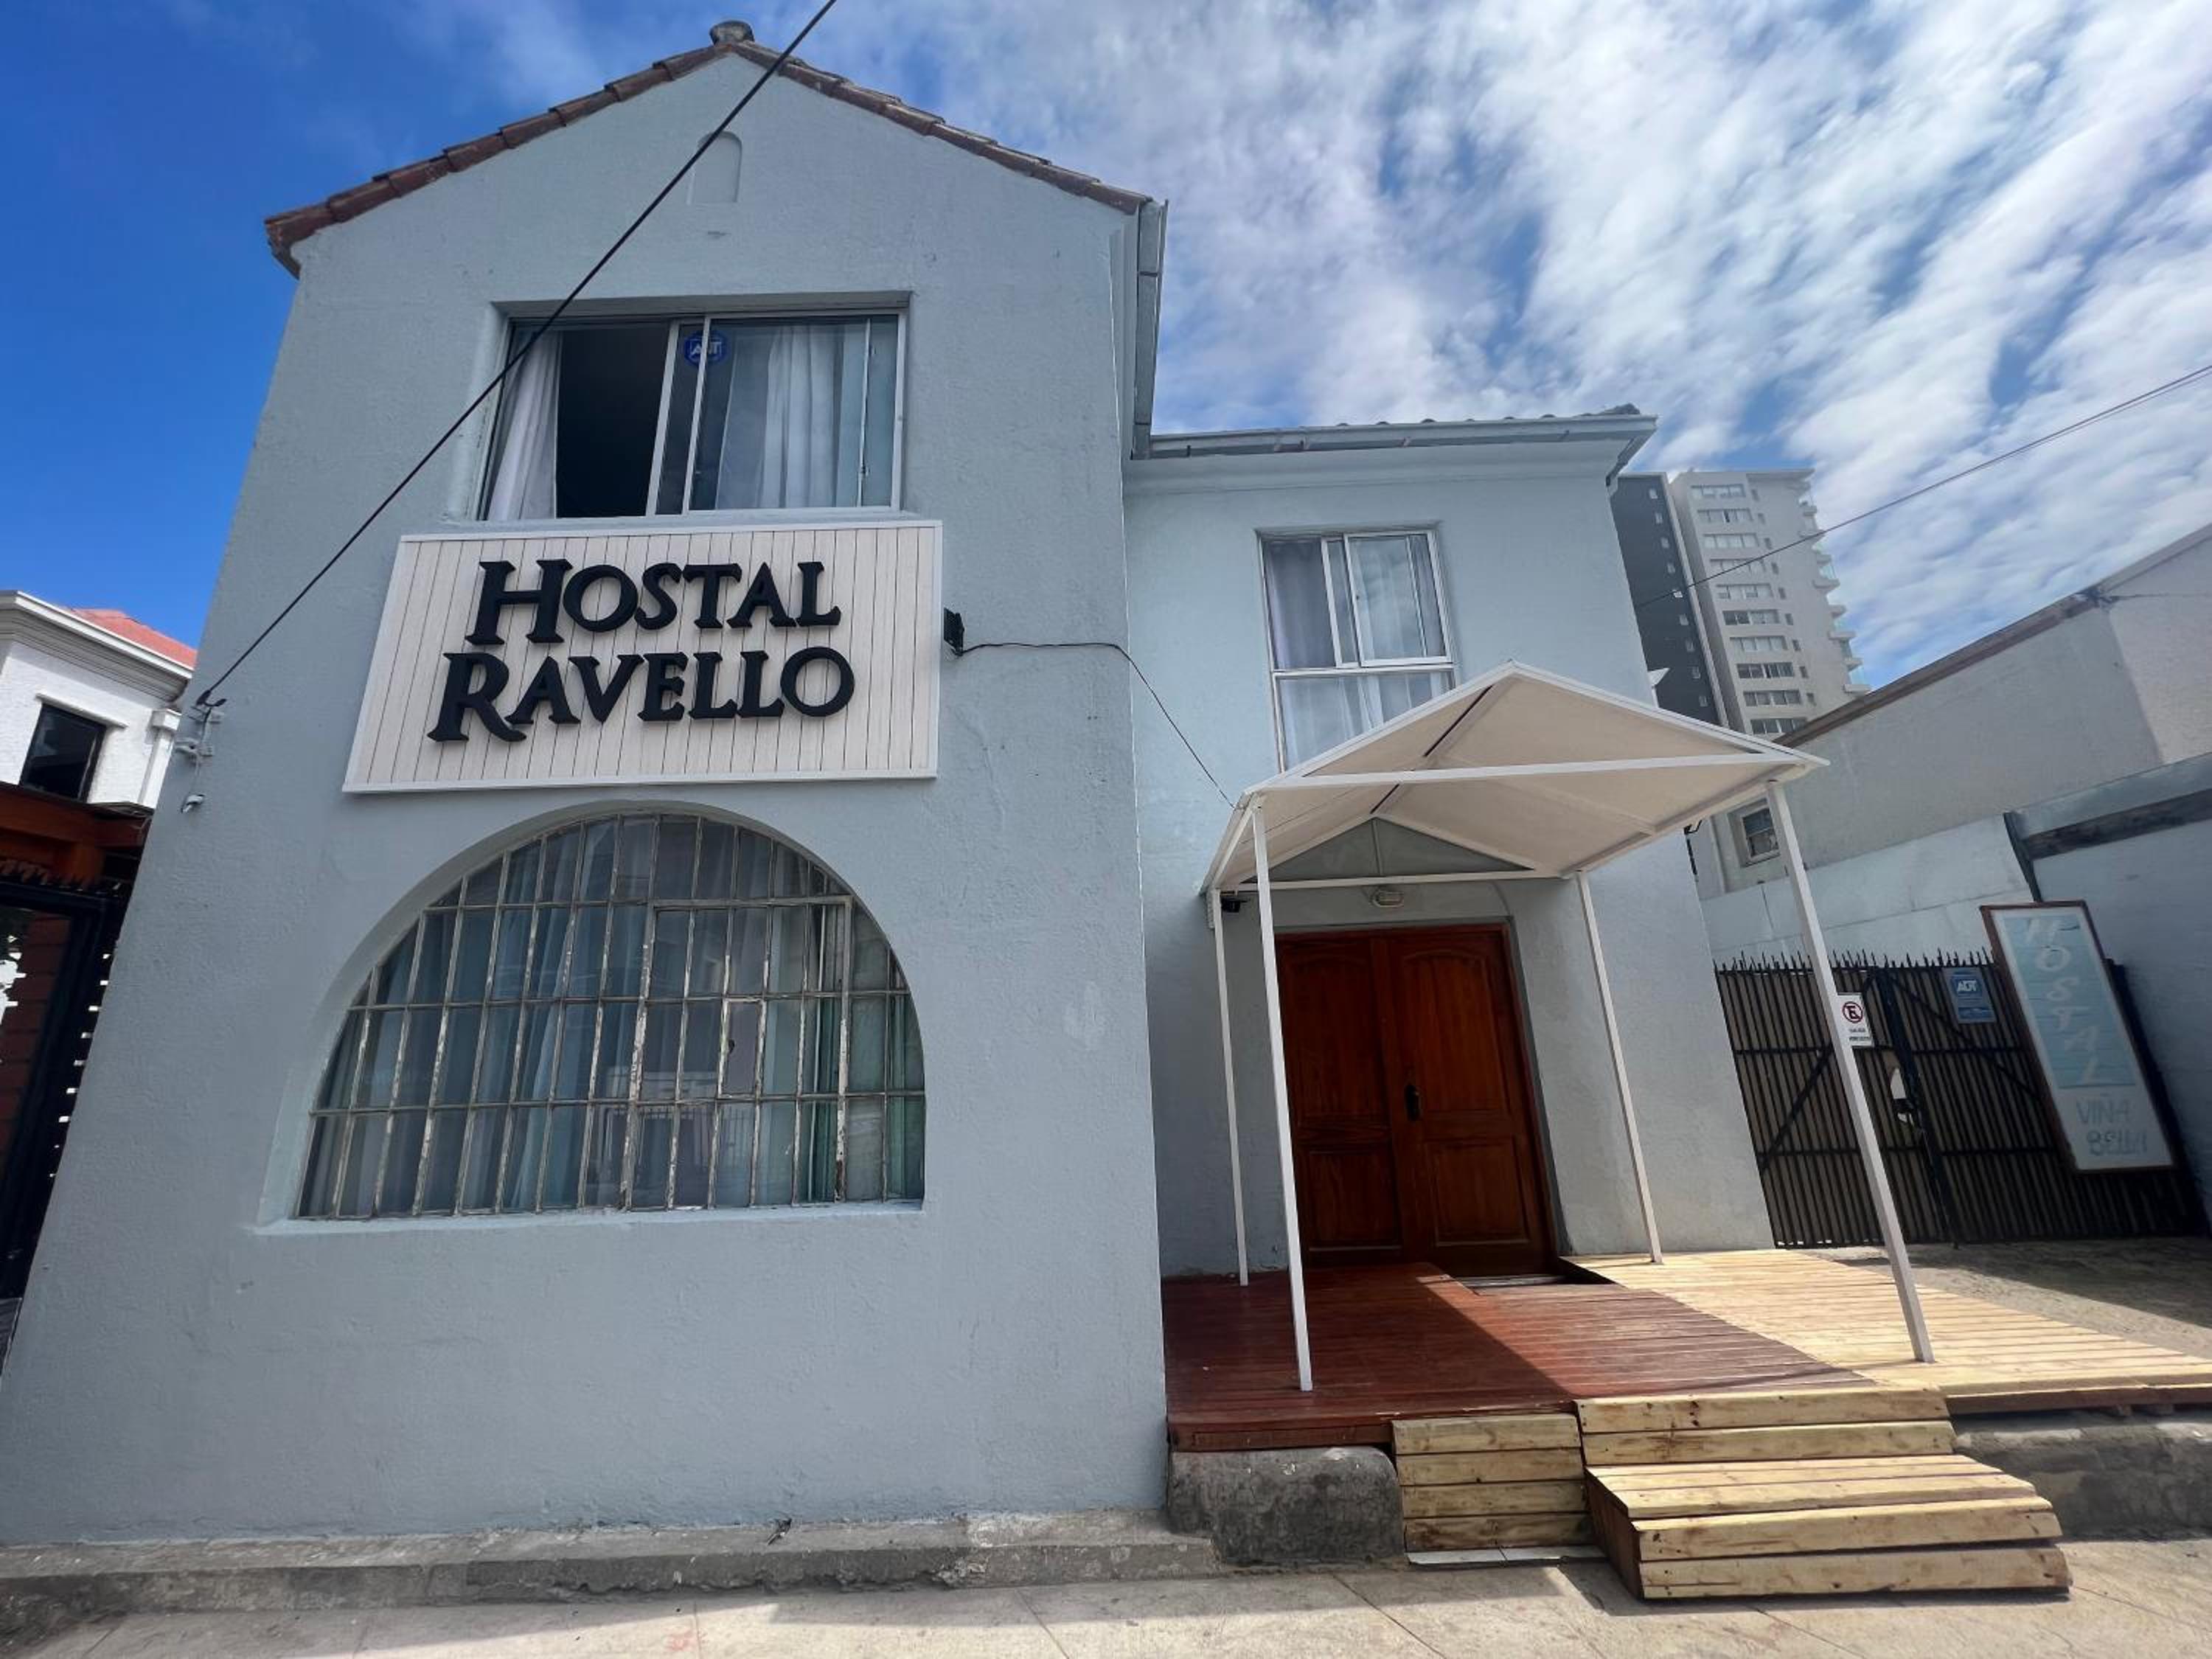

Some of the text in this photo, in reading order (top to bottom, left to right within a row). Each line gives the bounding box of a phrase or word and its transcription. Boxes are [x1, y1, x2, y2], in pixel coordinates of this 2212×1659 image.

[690, 341, 722, 355] AT
[465, 558, 841, 646] HOSTAL
[427, 646, 855, 742] RAVELLO
[1958, 980, 1977, 992] ADT
